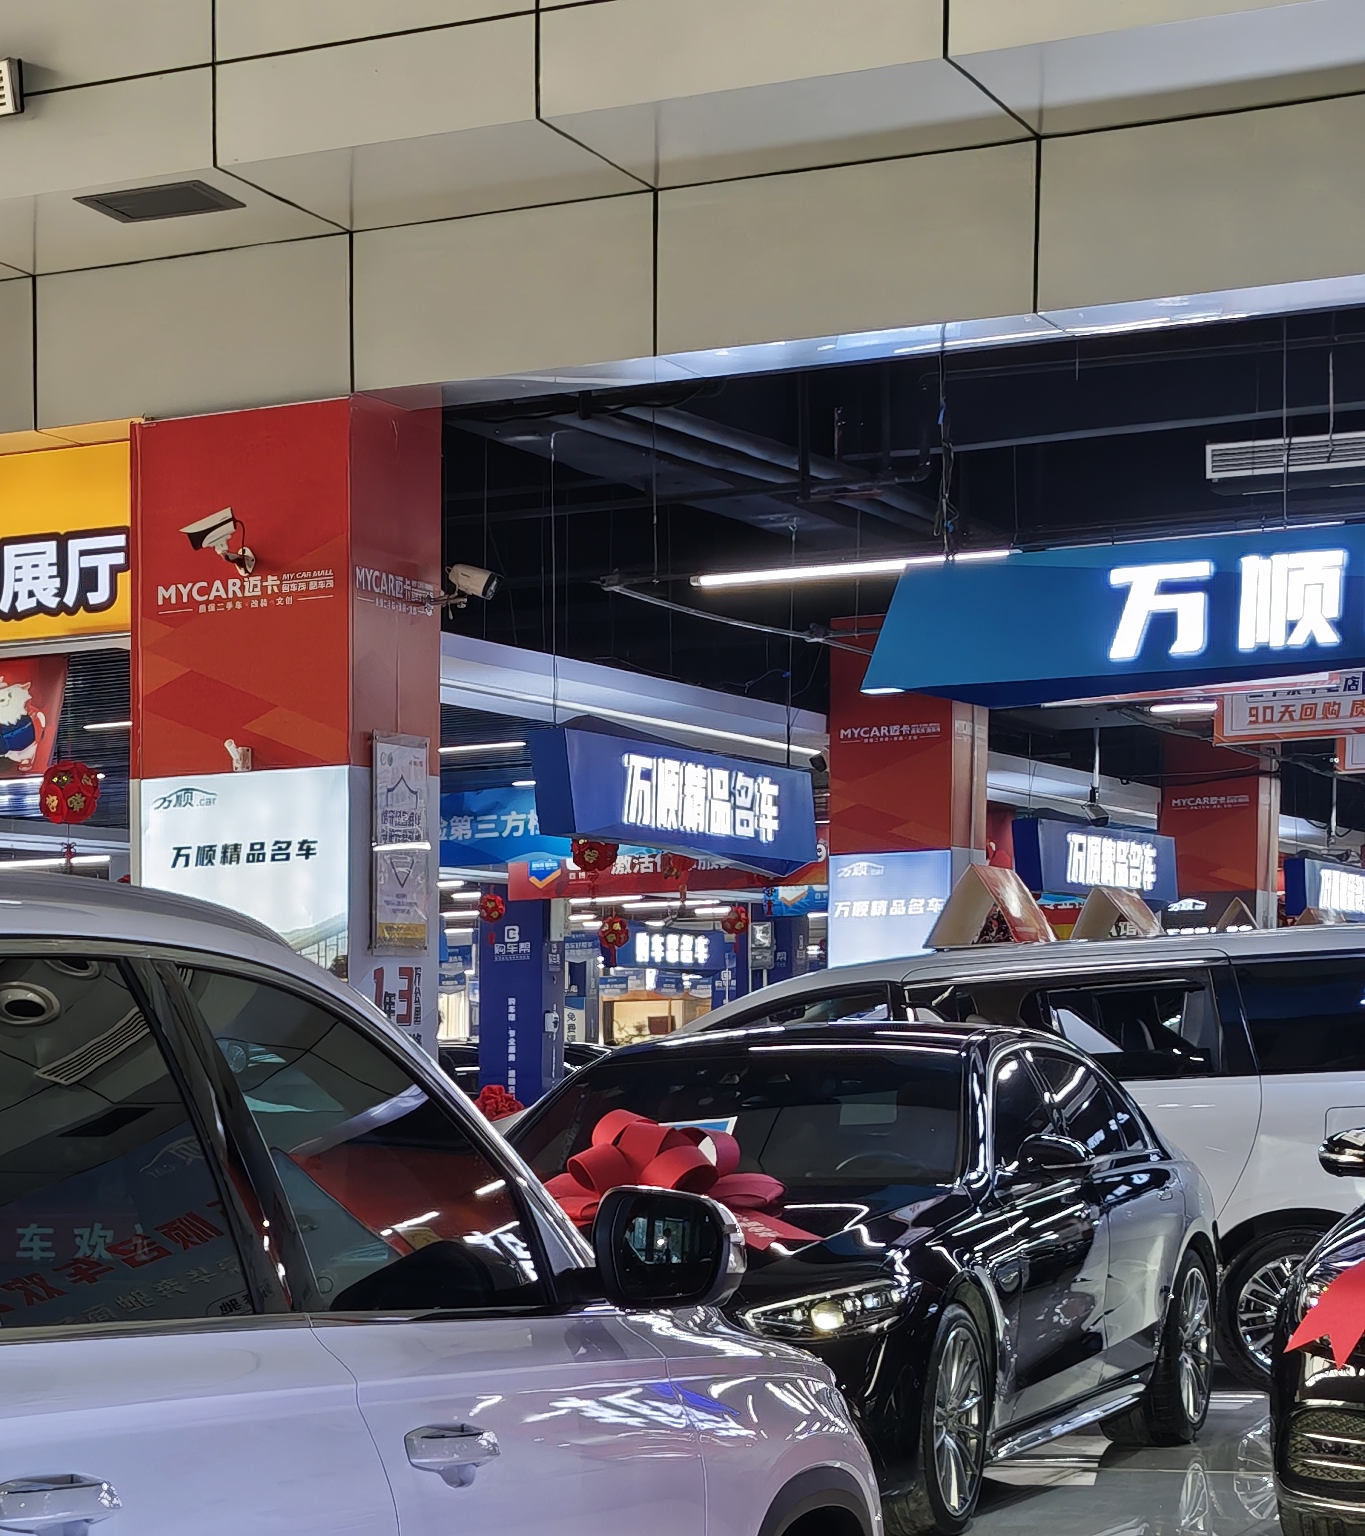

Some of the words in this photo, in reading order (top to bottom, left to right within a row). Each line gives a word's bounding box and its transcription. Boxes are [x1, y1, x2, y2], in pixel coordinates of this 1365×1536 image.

[157, 574, 281, 606] MYCAR迈卡
[1107, 549, 1348, 662] 万顺
[1247, 701, 1342, 726] 90天回购
[622, 753, 779, 843] 万顺精品名车
[171, 838, 319, 869] 万顺精品名车
